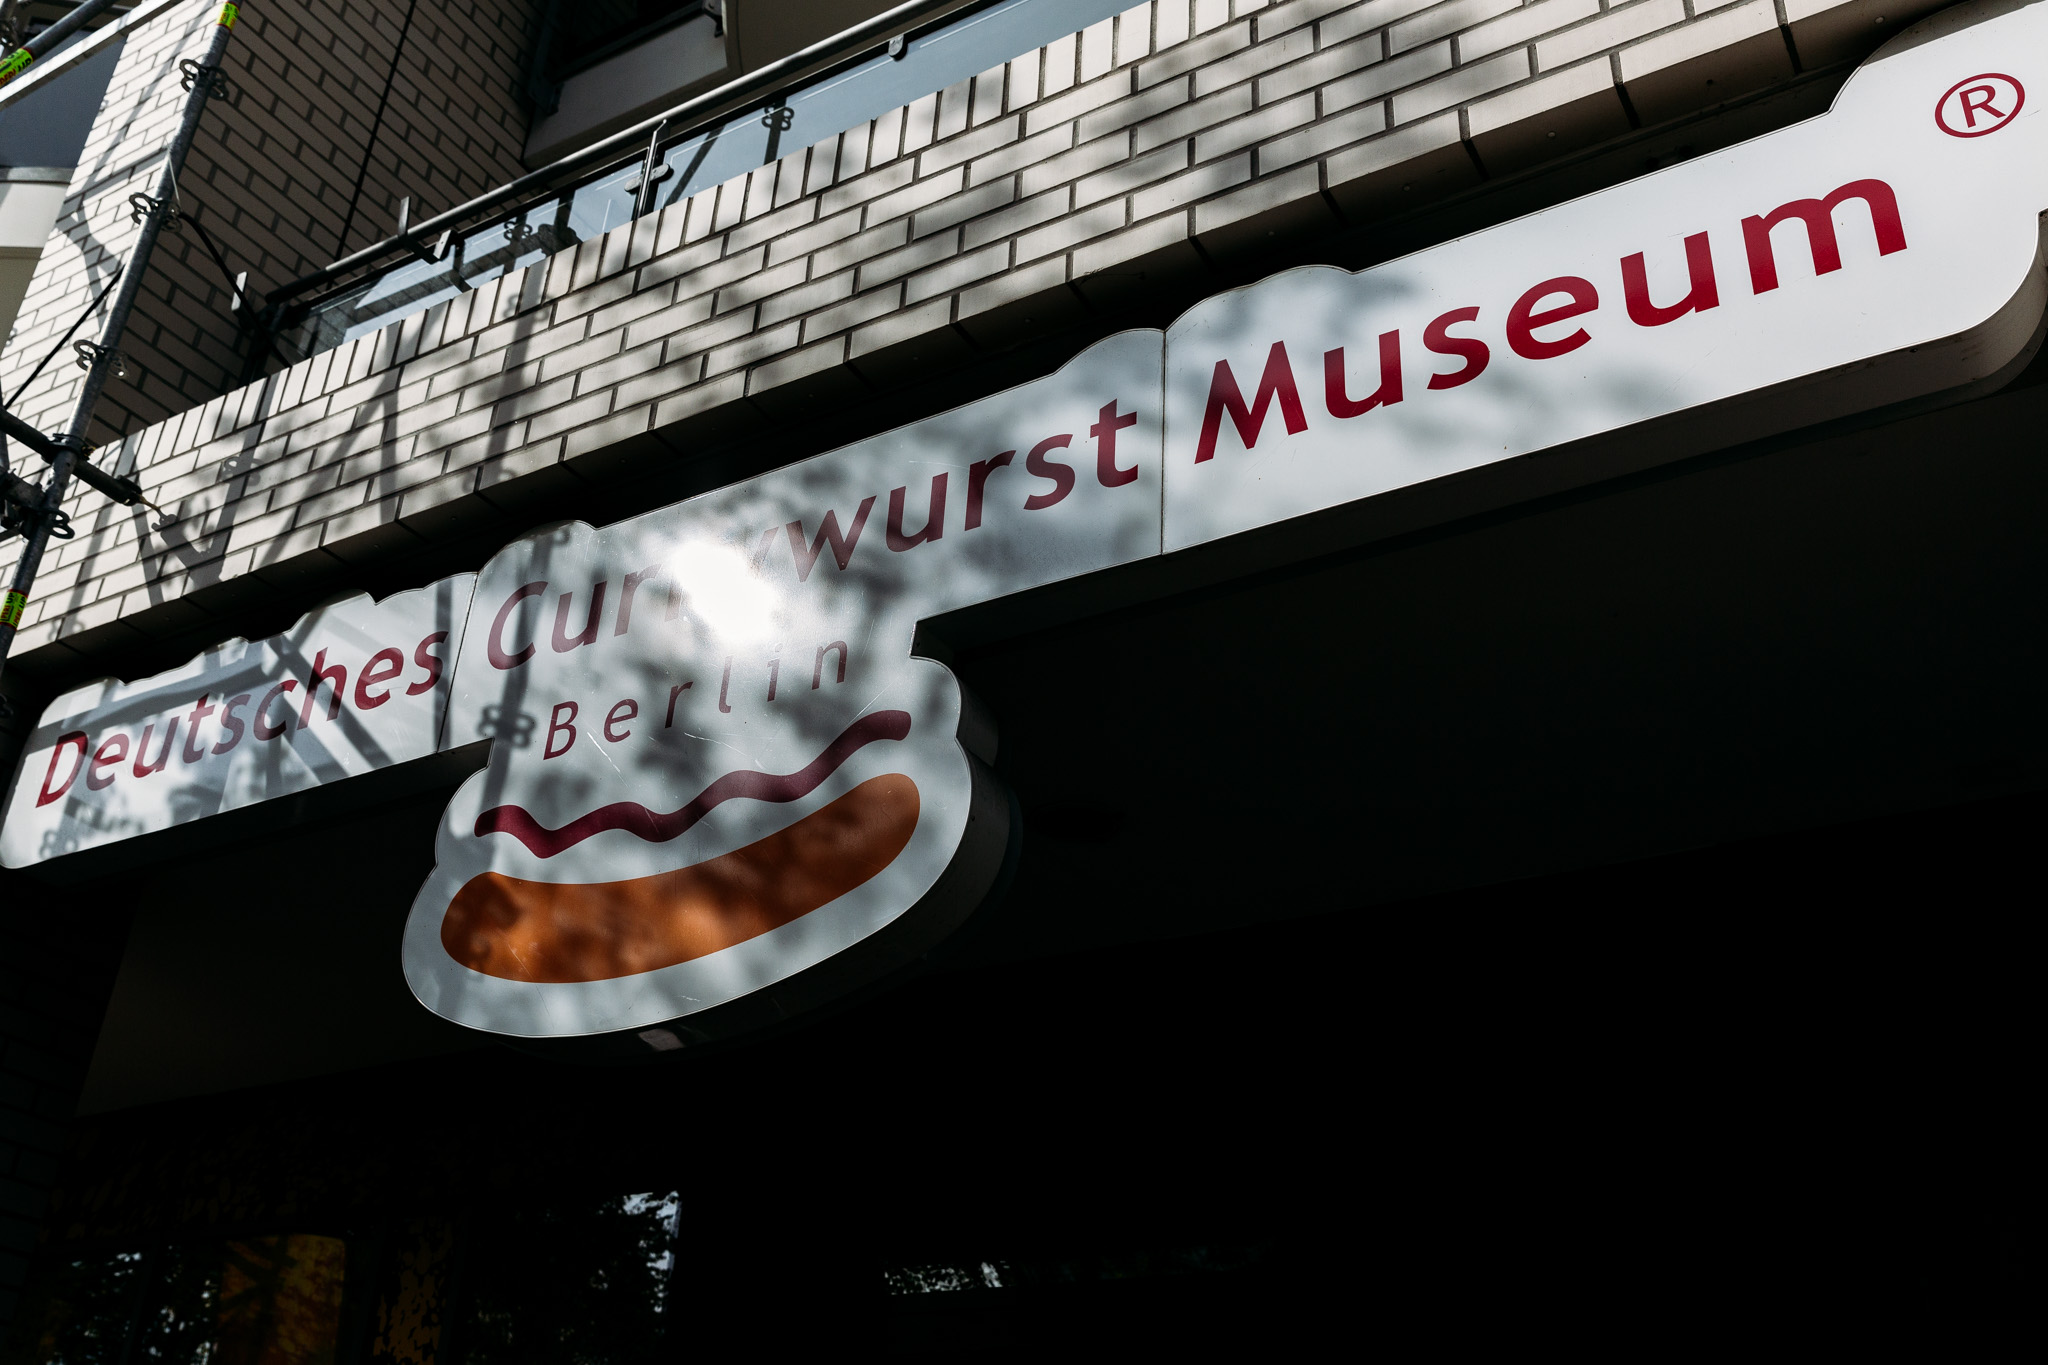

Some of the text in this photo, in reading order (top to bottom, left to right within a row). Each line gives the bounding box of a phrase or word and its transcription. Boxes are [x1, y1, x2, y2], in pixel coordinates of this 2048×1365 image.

[36, 631, 449, 808] Deutsches
[487, 398, 1139, 670] Curwurst
[1194, 179, 1908, 464] Museum
[543, 639, 848, 760] Berlin
